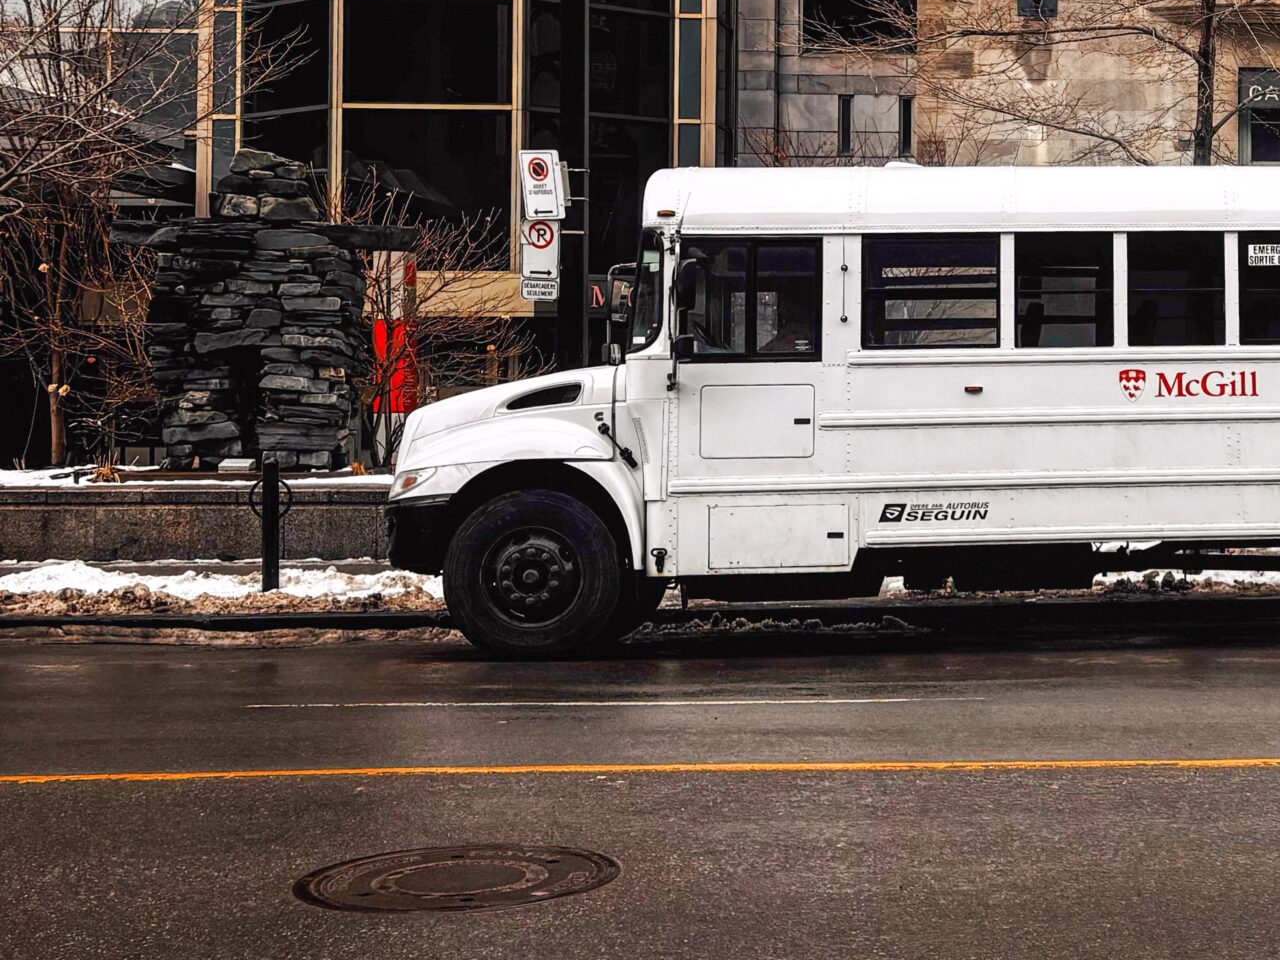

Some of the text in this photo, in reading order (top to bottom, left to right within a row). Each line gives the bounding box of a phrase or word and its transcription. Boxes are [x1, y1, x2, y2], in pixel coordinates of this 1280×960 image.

[1249, 255, 1276, 265] SORTIE
[1155, 370, 1260, 398] McGill
[945, 502, 990, 510] AUTOBUS
[905, 509, 989, 522] SEGUIN
